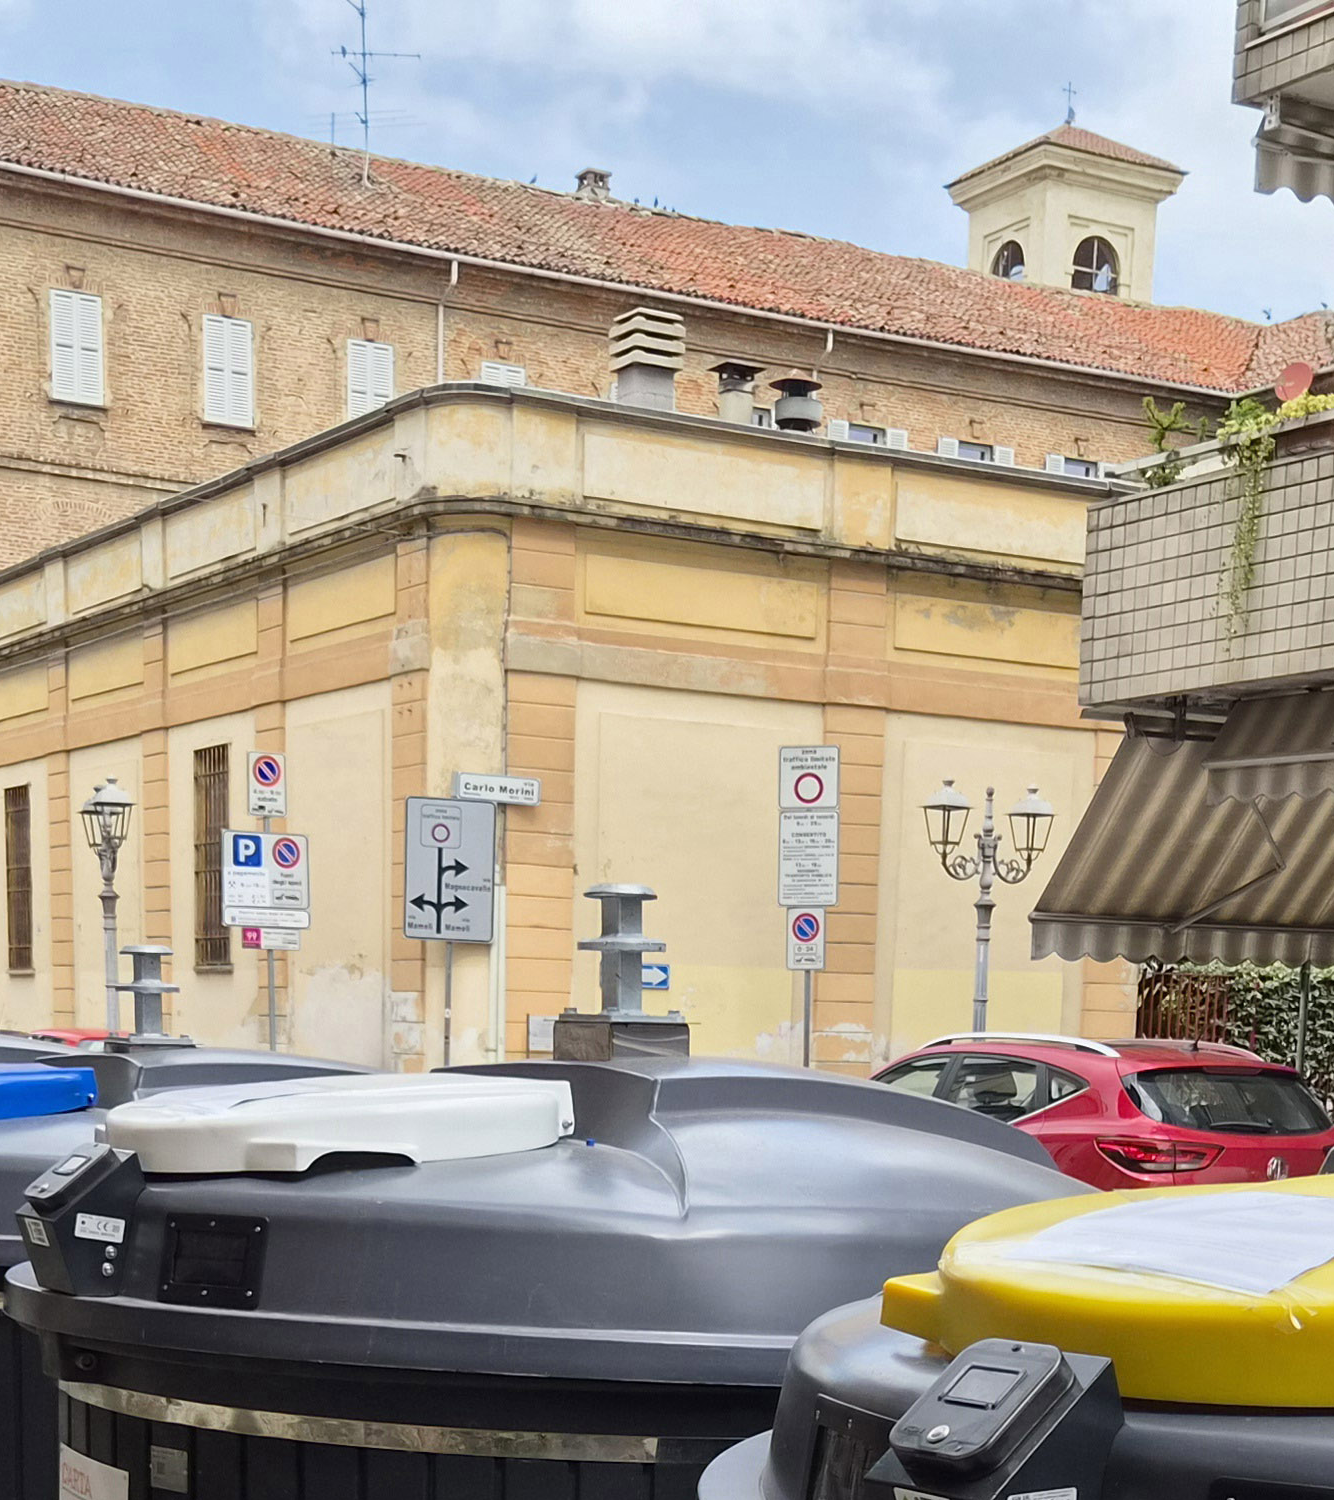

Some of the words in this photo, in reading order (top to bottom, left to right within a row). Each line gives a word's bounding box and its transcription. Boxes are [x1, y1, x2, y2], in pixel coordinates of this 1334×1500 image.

[464, 782, 495, 793] Carlo
[499, 785, 535, 796] Morini
[238, 838, 256, 863] P
[62, 1462, 93, 1499] CARTA
